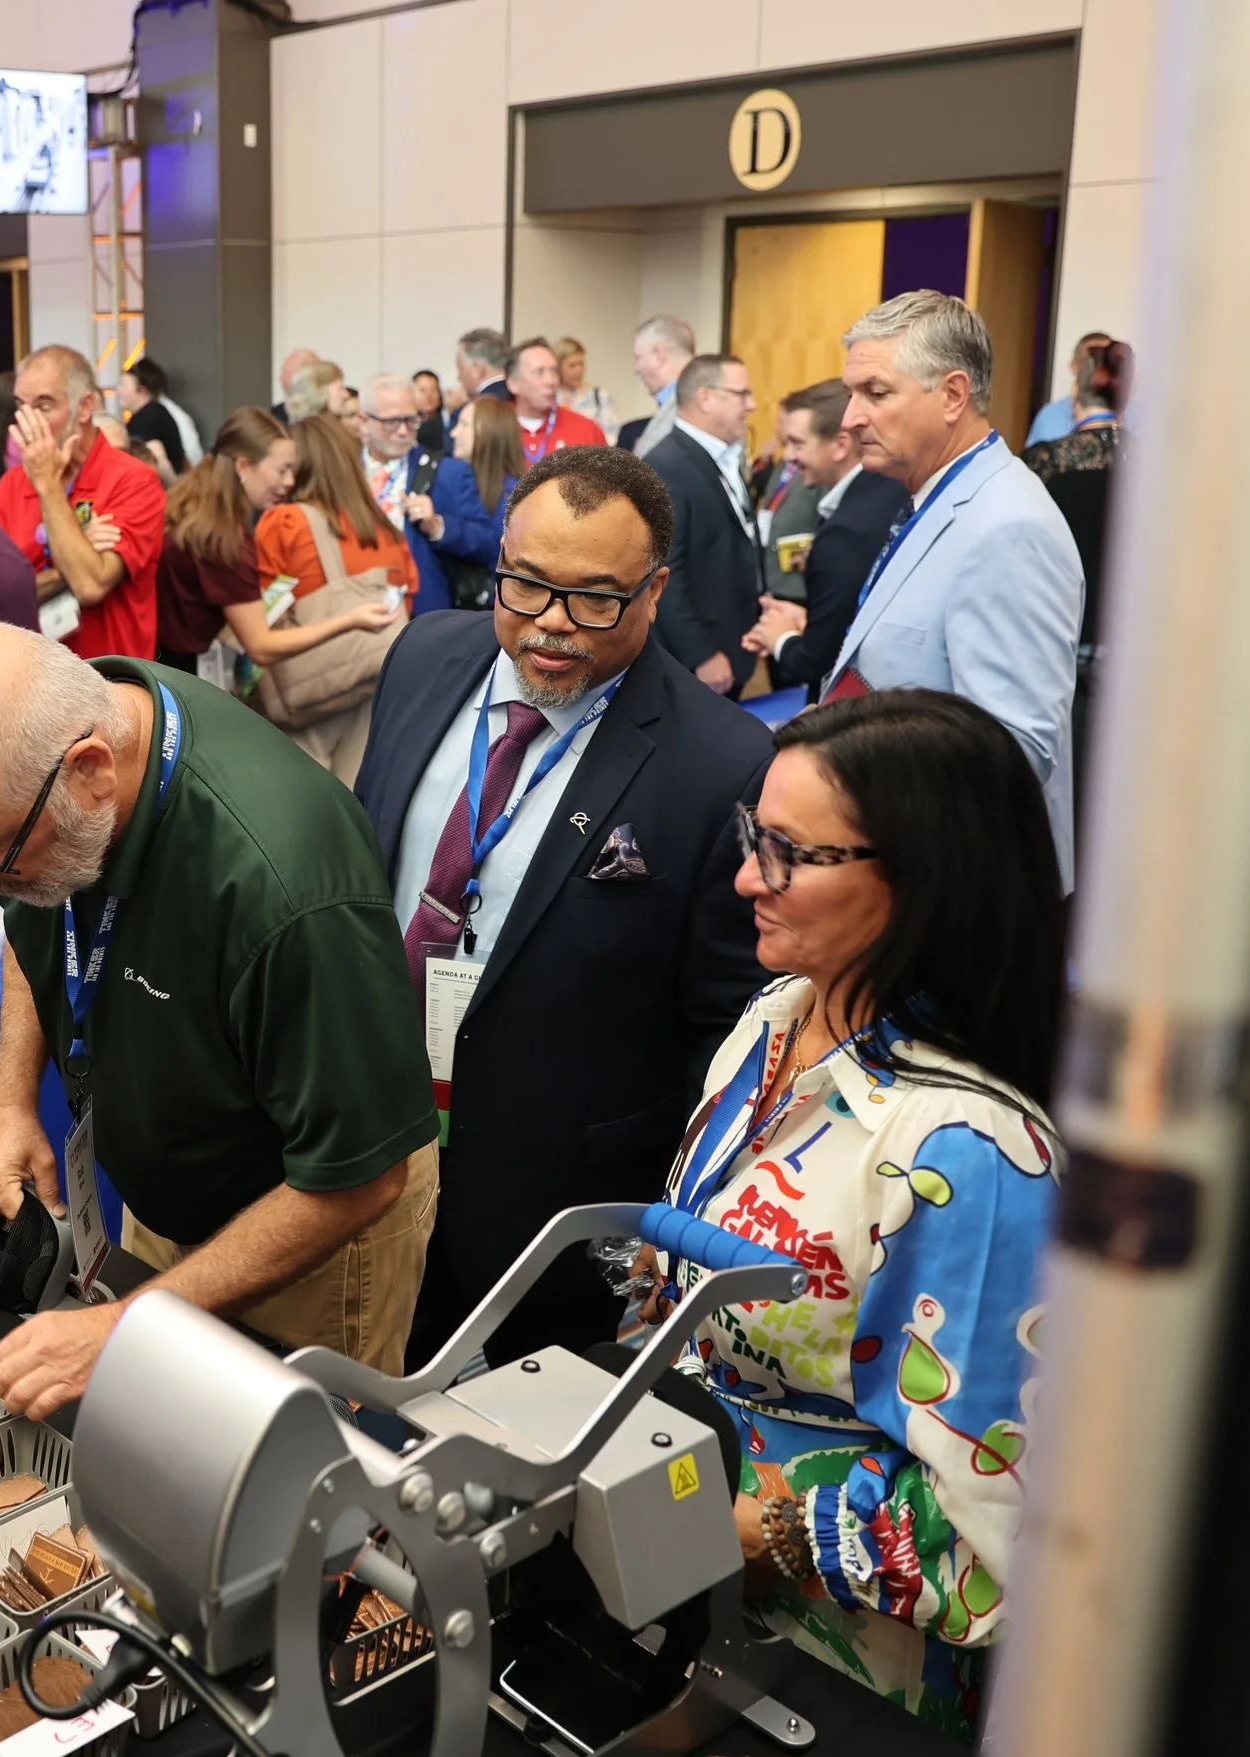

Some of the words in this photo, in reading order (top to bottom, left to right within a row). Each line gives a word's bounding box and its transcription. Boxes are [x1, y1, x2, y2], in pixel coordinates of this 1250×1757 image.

[741, 106, 792, 176] D
[70, 931, 79, 977] TINKER
[83, 947, 99, 983] TINKER
[433, 969, 458, 978] AGENDA
